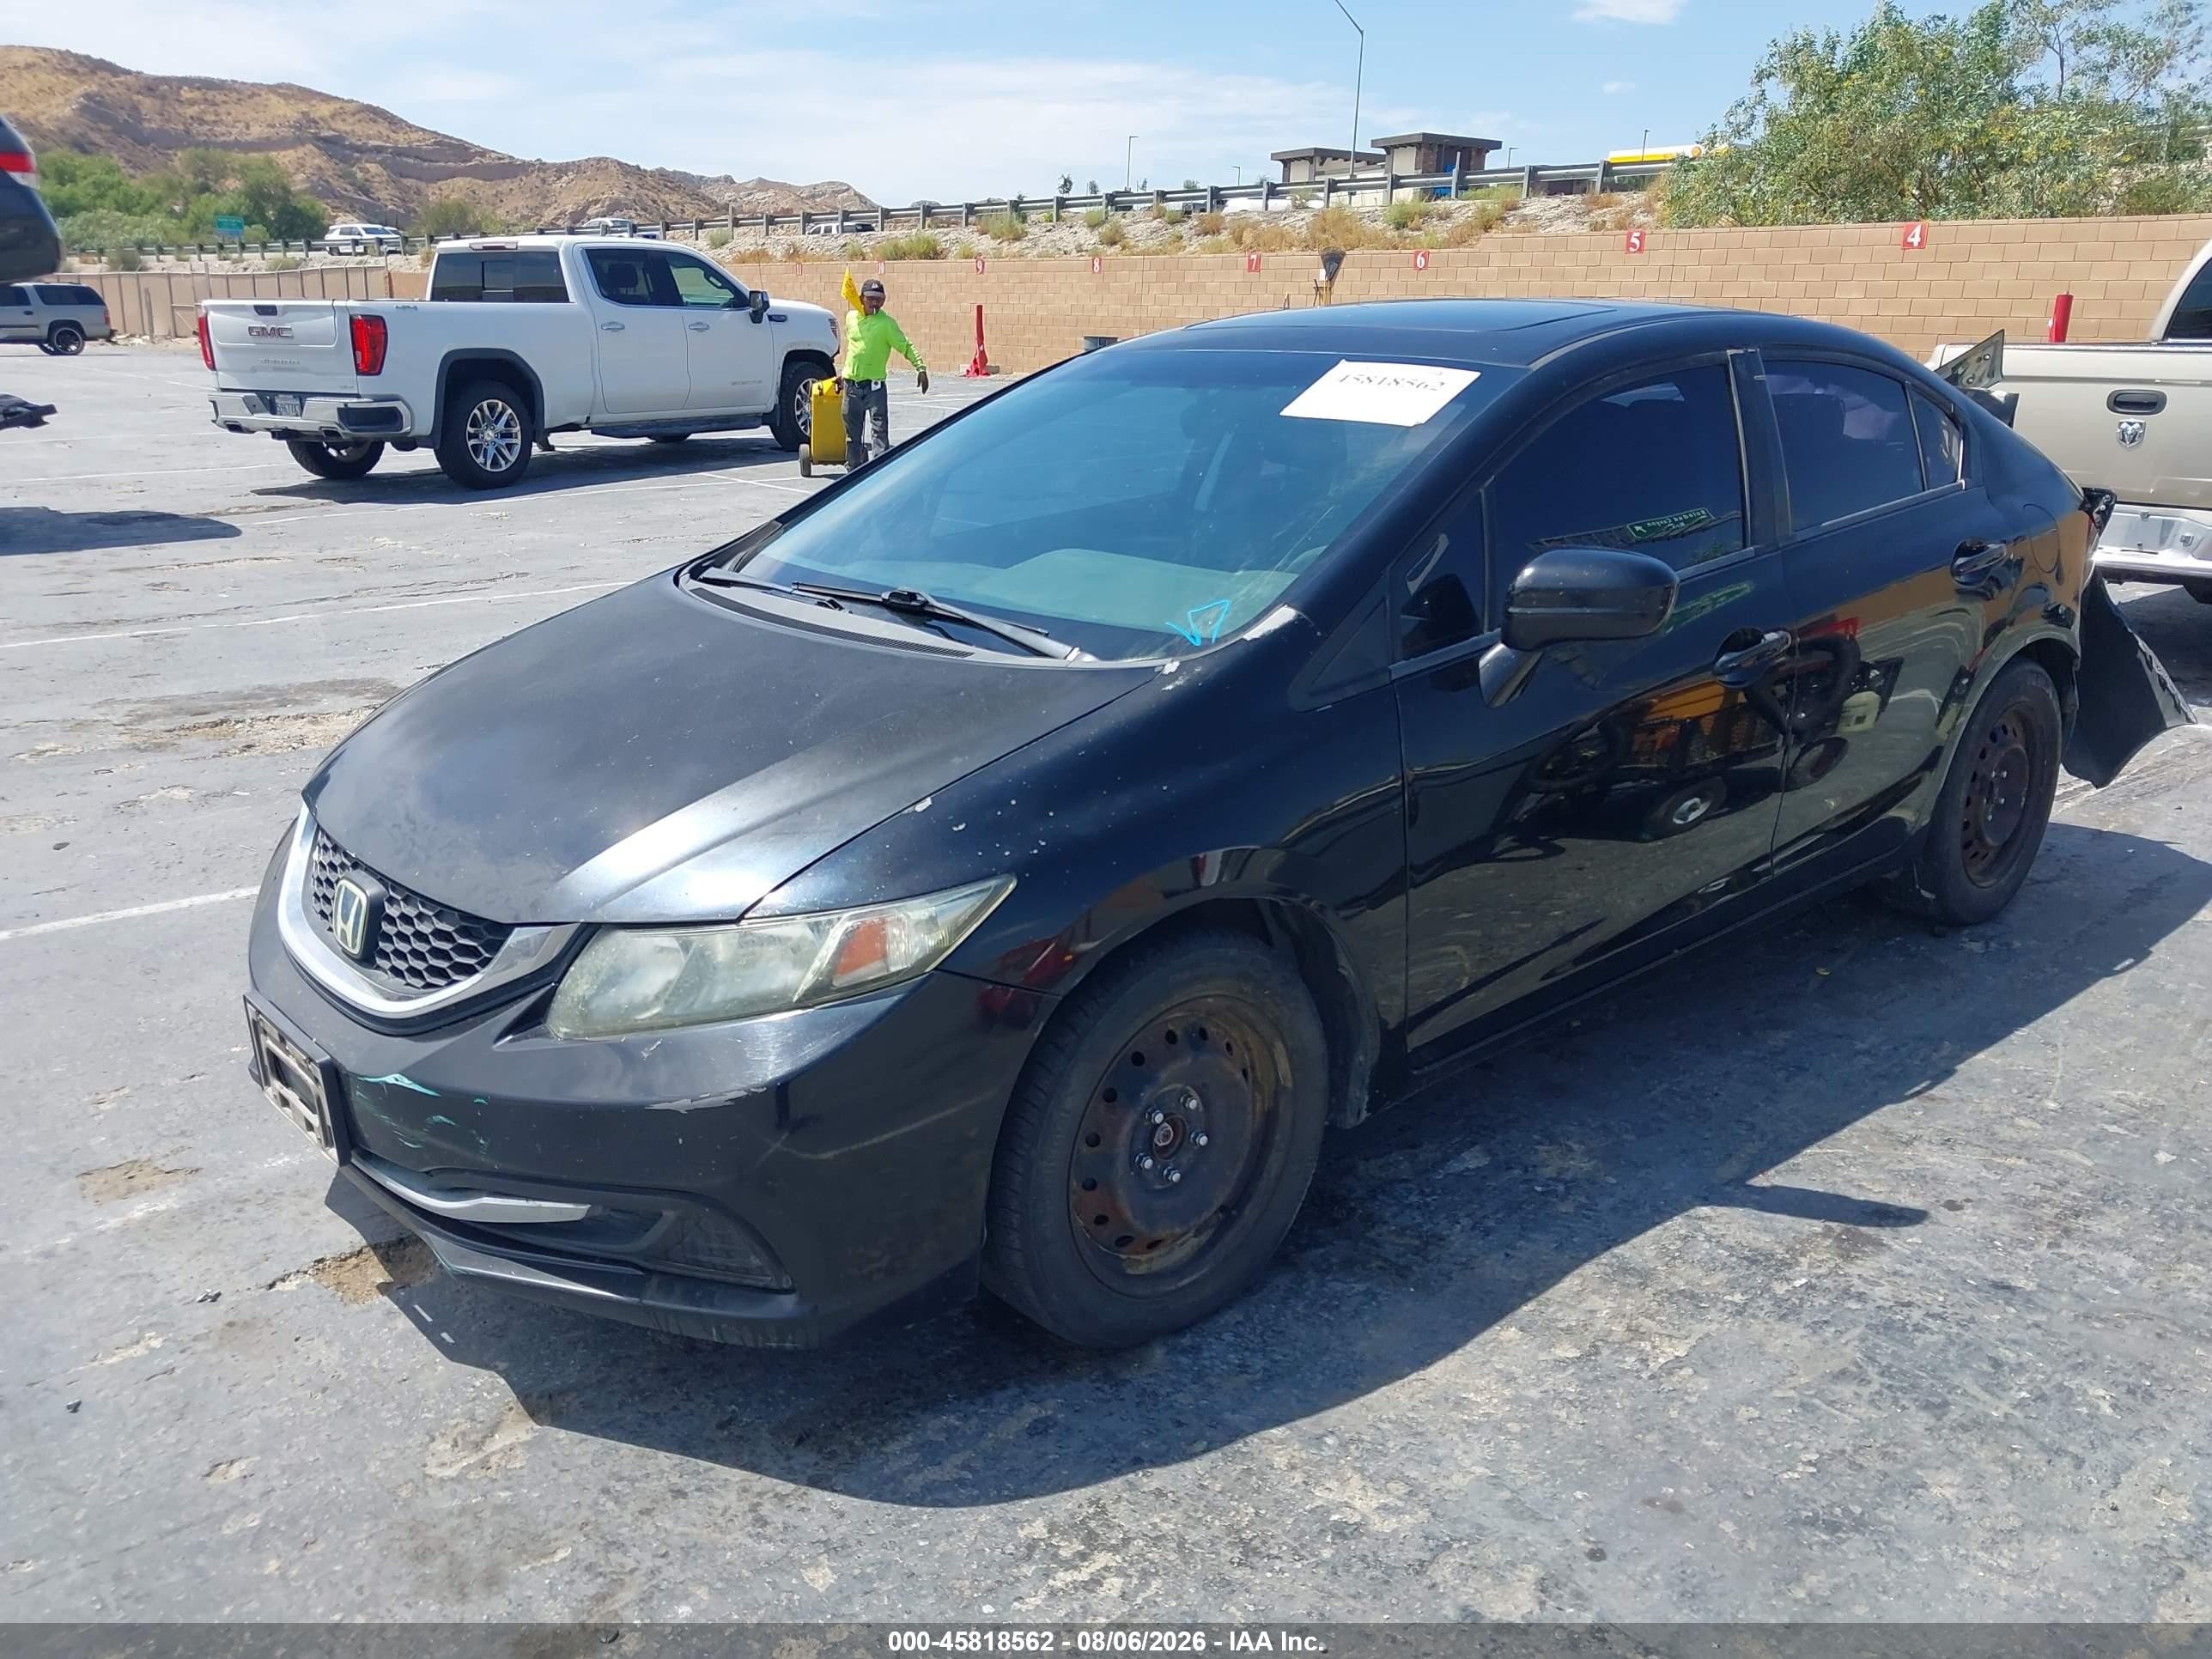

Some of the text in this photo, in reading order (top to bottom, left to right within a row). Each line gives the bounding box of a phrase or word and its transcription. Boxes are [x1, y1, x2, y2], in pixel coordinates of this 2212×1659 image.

[1629, 232, 1640, 252] 5
[1907, 224, 1921, 246] 4
[977, 260, 982, 274] 9
[1094, 258, 1100, 272] 8
[1250, 254, 1258, 270] 7
[1417, 251, 1425, 268] 6
[796, 264, 803, 275] 11
[248, 325, 293, 337] GMC
